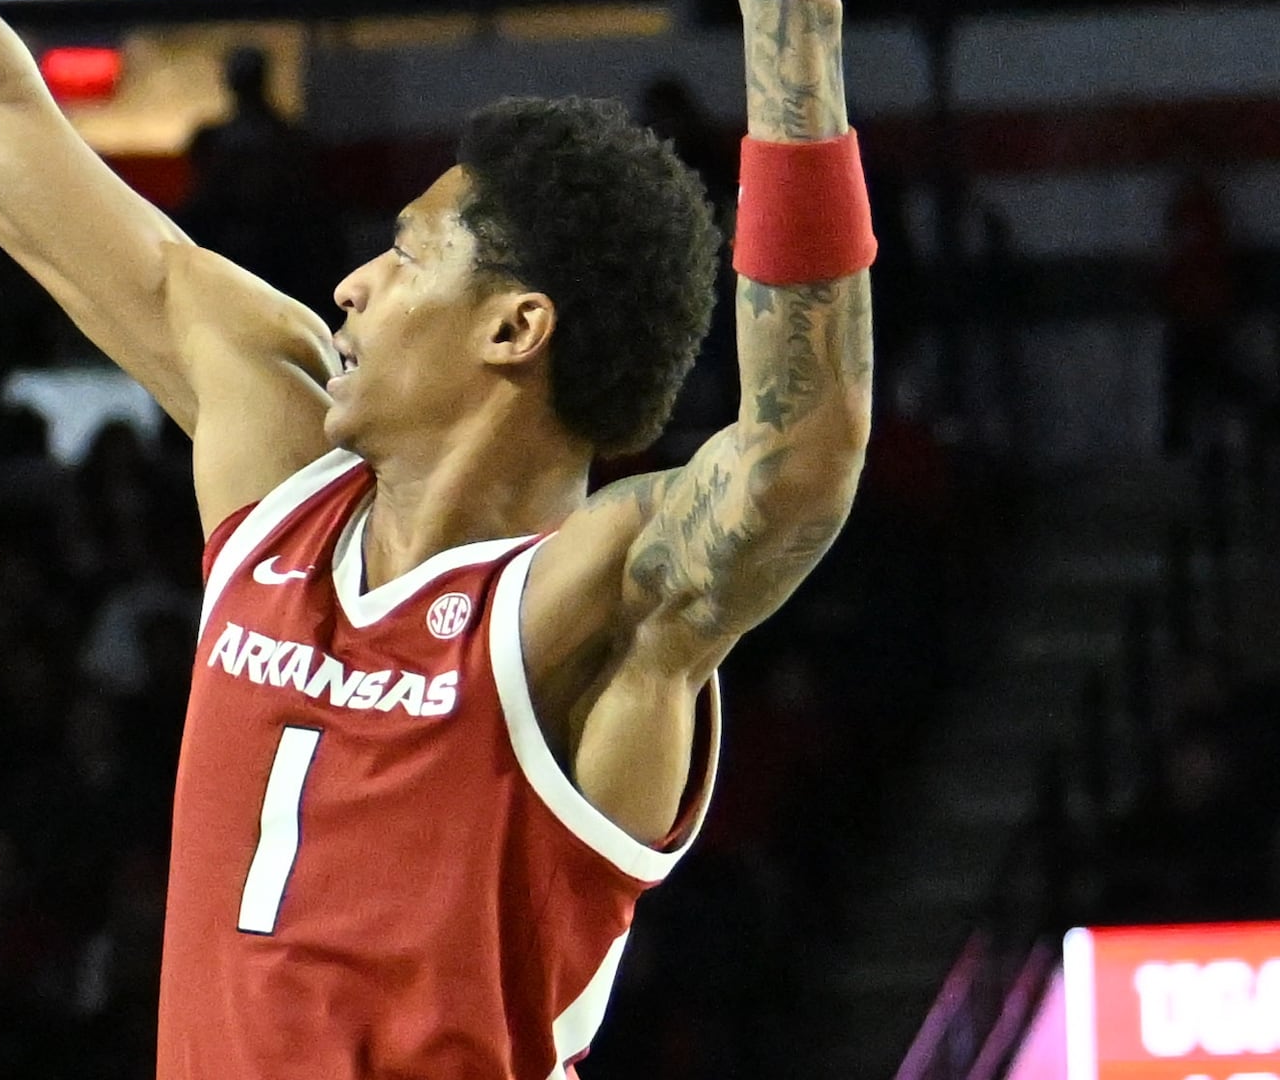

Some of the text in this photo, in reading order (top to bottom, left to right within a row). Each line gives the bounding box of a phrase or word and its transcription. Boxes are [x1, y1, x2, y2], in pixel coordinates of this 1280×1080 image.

[428, 594, 470, 637] SEC
[207, 621, 459, 717] ARKANSAS
[236, 724, 324, 936] 1
